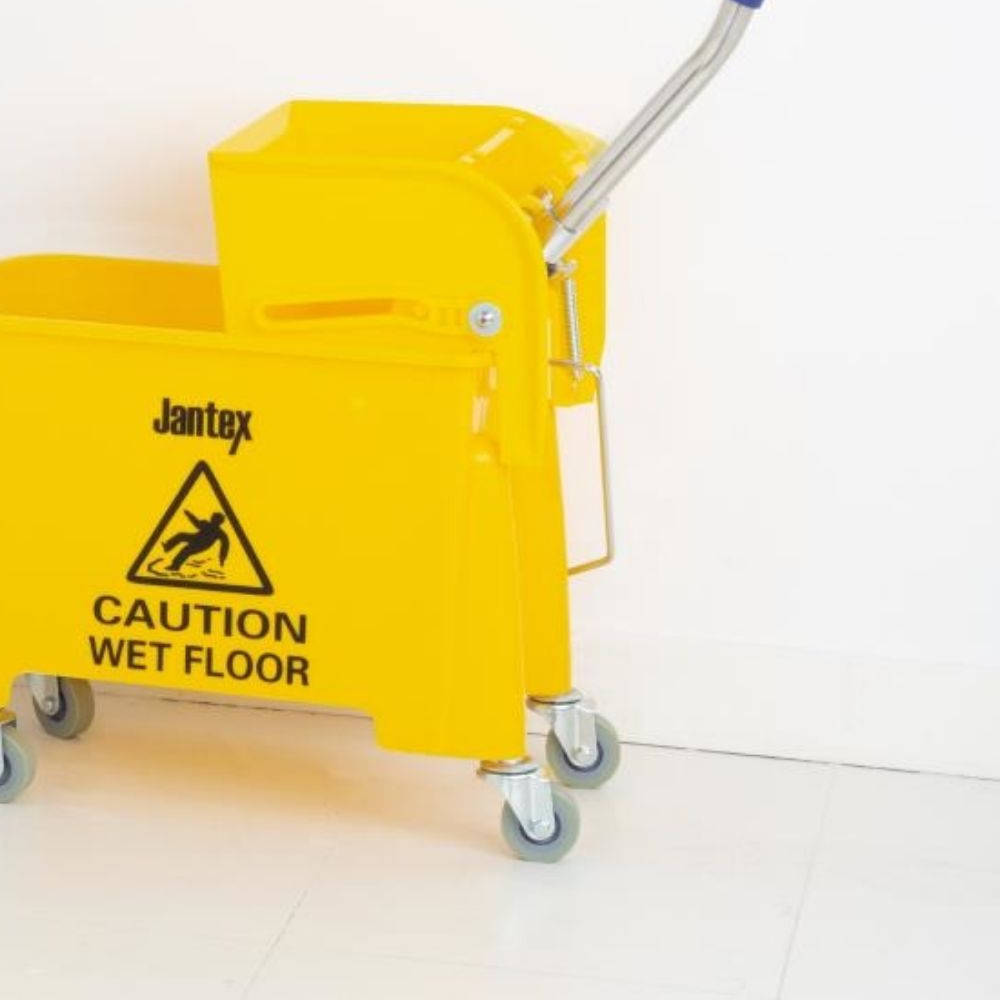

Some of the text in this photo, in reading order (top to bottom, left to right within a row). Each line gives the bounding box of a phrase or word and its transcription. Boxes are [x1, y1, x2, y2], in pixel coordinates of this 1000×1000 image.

[152, 397, 253, 456] Jantex
[92, 595, 308, 645] CAUTION
[88, 635, 311, 687] WET FLOOR
